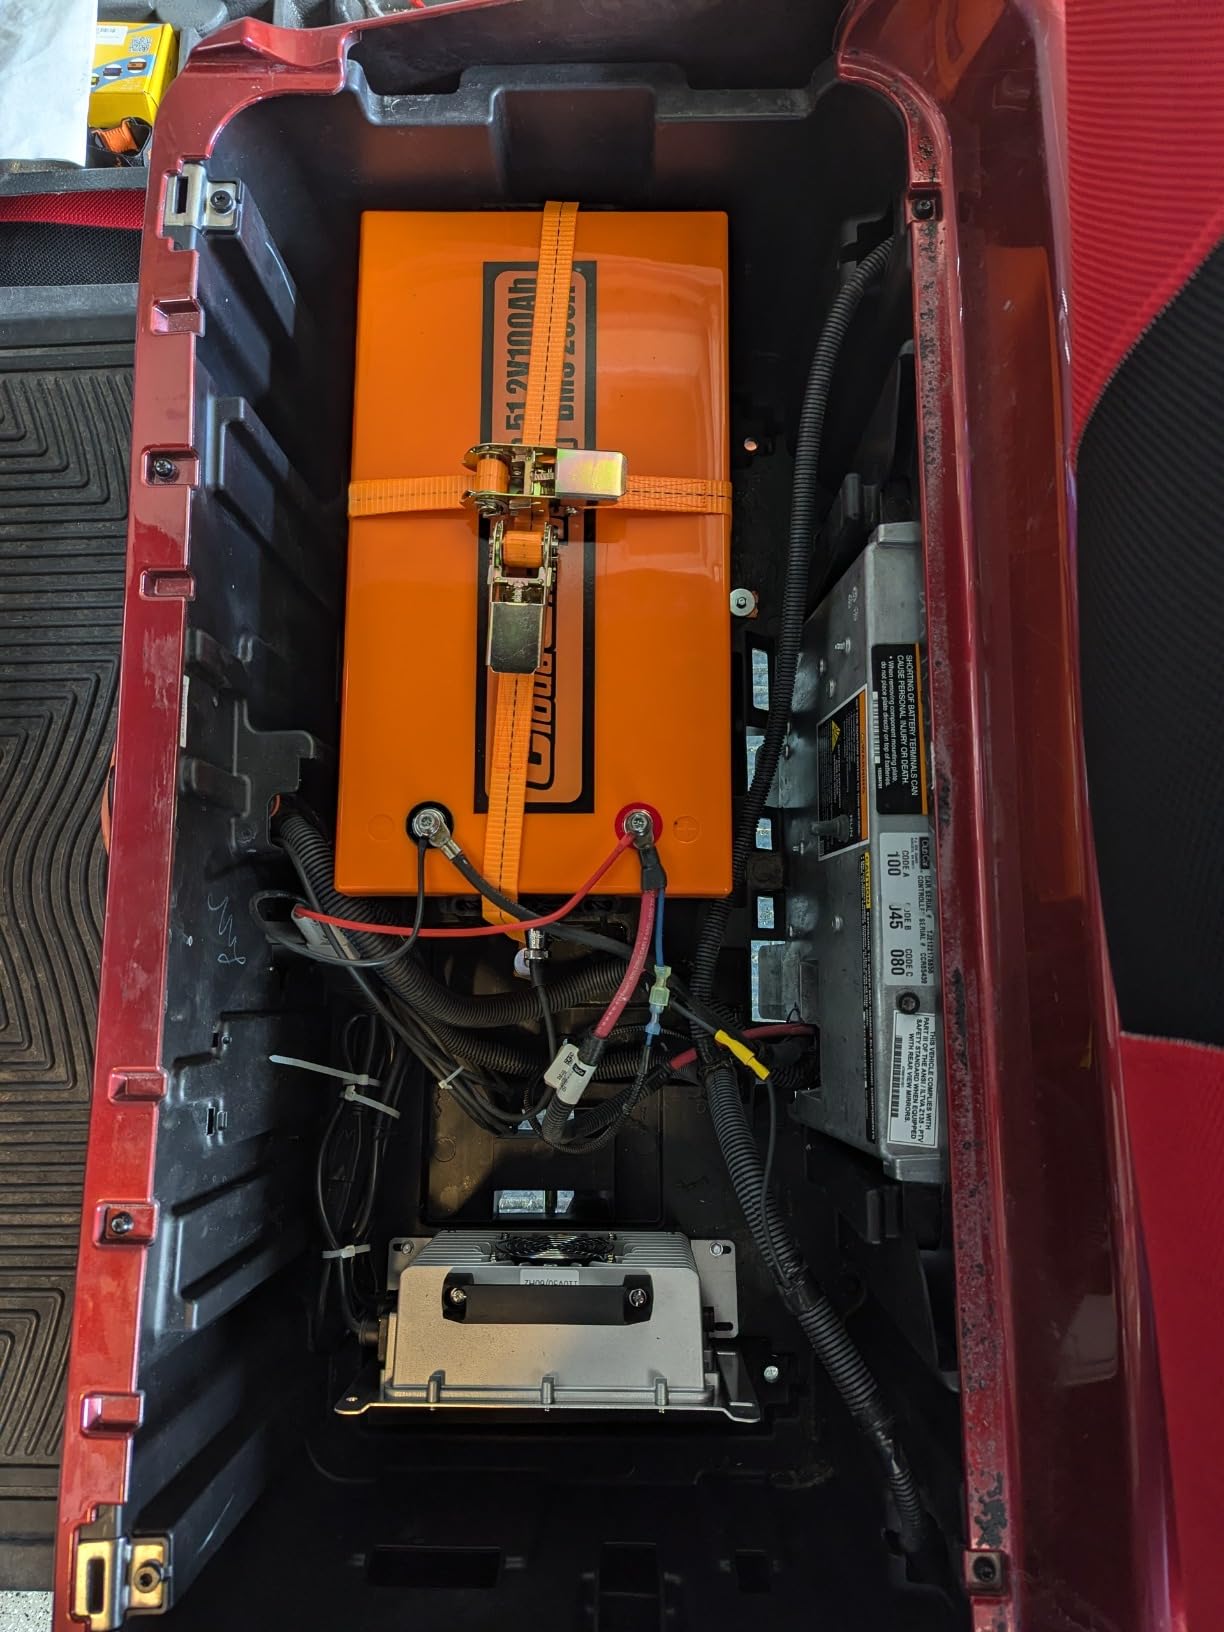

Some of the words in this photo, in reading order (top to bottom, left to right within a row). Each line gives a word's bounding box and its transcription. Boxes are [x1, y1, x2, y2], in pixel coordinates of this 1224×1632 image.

[897, 655, 905, 678] CAUSE
[906, 655, 914, 691] SHORTING
[898, 681, 906, 718] PERSONAL
[908, 694, 914, 703] OF
[882, 712, 890, 732] directly
[901, 747, 907, 758] OR
[887, 851, 901, 876] 100
[888, 904, 903, 929] J45
[890, 949, 905, 976] 080
[922, 1043, 928, 1053] OF
